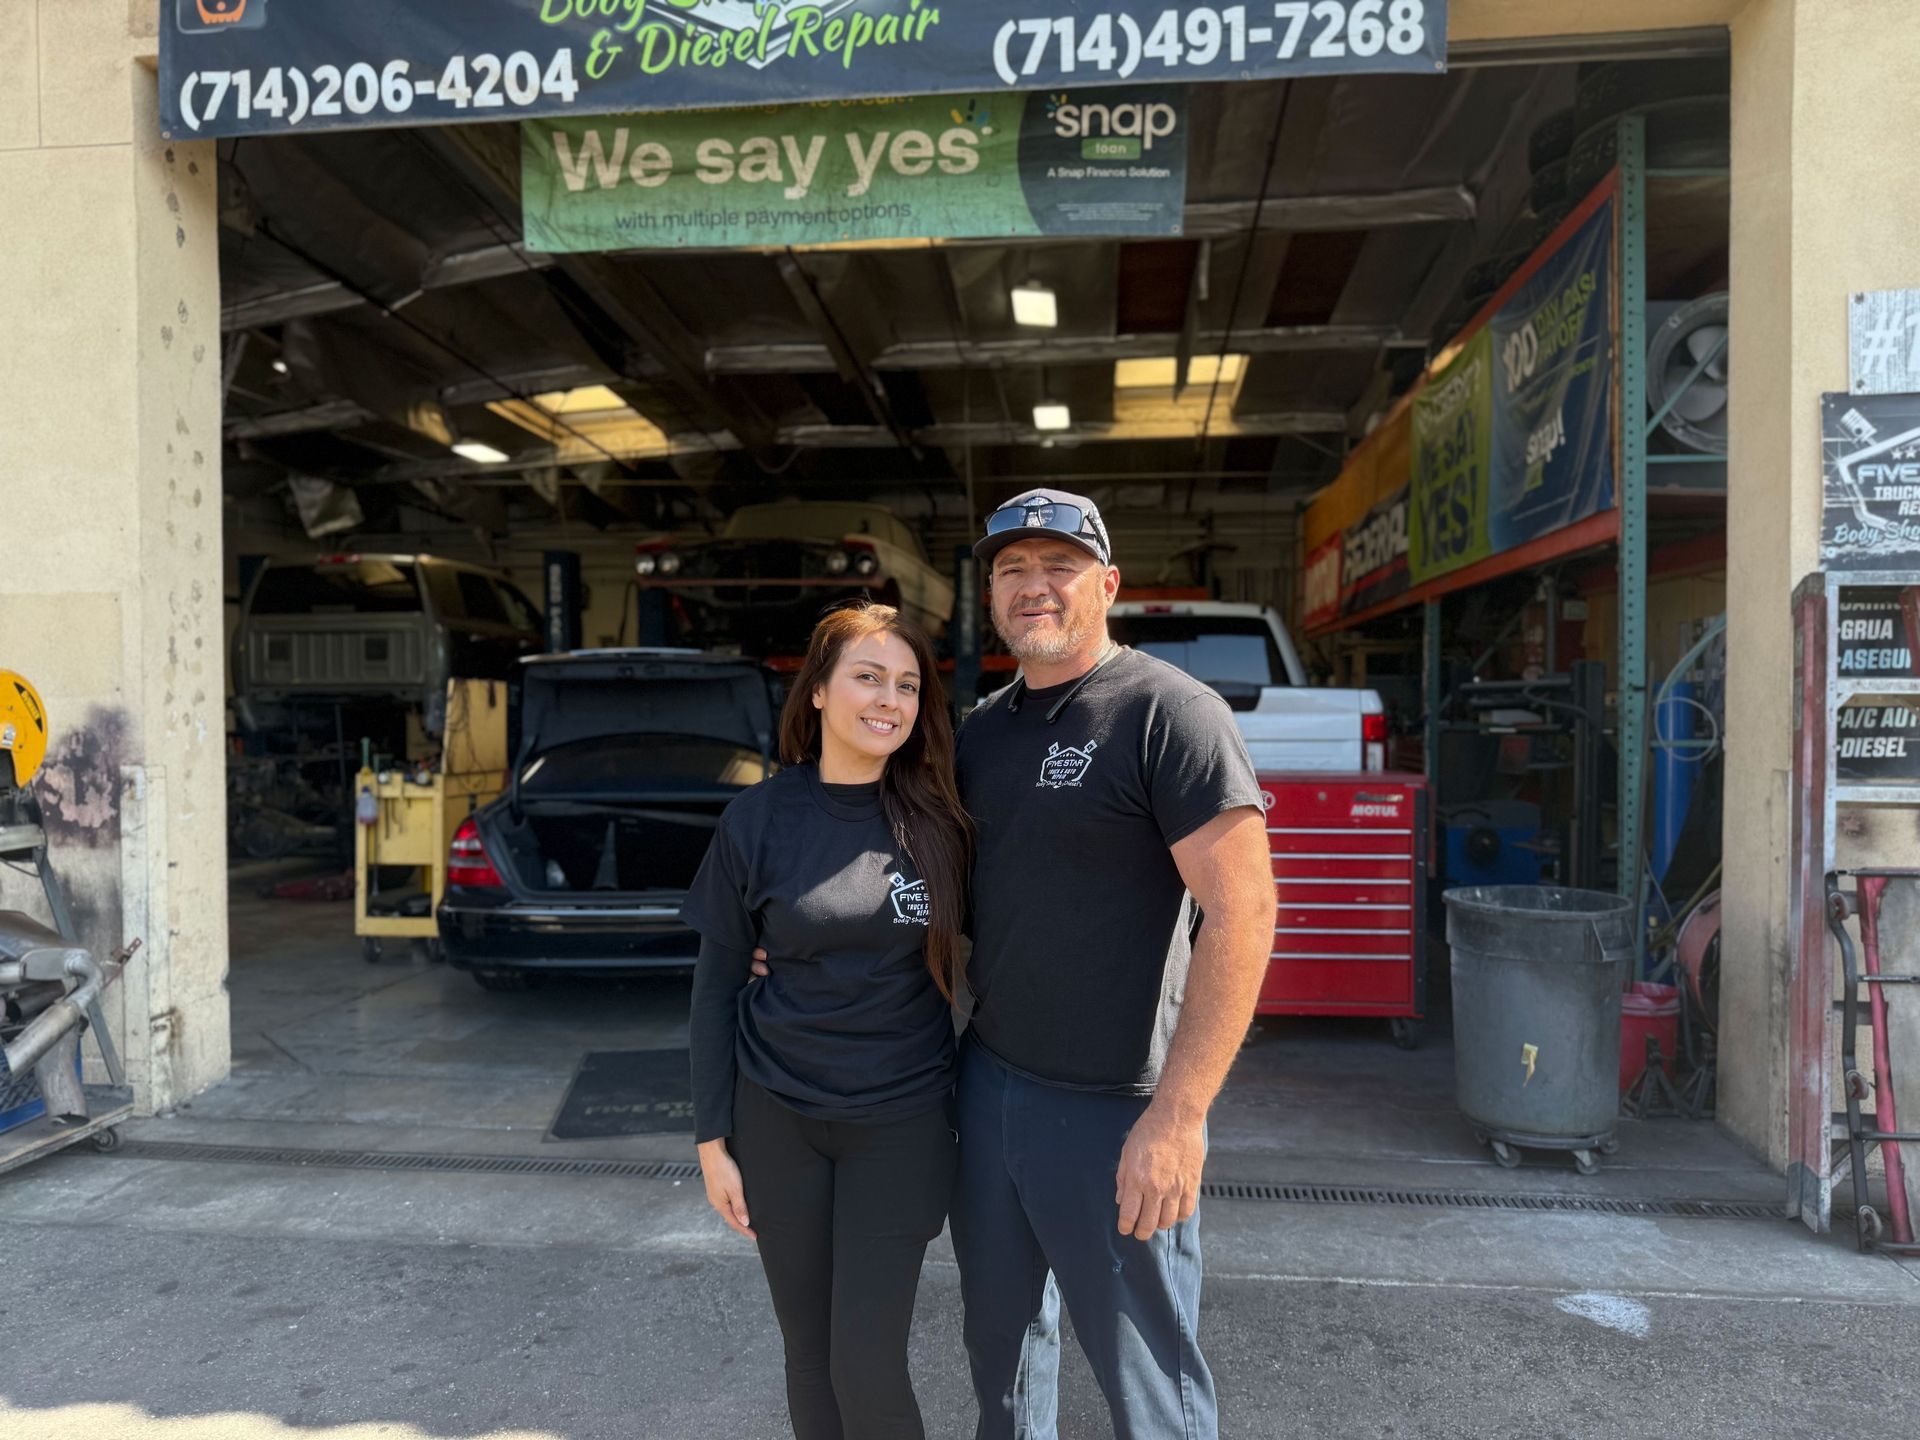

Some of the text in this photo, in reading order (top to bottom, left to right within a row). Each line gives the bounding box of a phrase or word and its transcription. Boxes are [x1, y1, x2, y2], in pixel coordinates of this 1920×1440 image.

[585, 0, 939, 79] & Diesel Repair
[993, 0, 1425, 85] (714)491-7268
[179, 48, 579, 132] (714)206-4204
[1054, 103, 1177, 149] snap
[1096, 142, 1127, 154] loan
[552, 128, 980, 200] We say yes
[1047, 166, 1170, 179] A Snap Finance Solution
[615, 202, 911, 230] with multiple payment options
[1857, 463, 1920, 485] FIVE
[1898, 501, 1920, 516] RE
[1832, 522, 1879, 547] Body
[1840, 618, 1893, 640] GRUA
[1840, 707, 1878, 729] A/C
[1840, 736, 1907, 758] DIESEL
[1047, 759, 1084, 768] FIVE STAR
[1350, 804, 1400, 817] MOTUL
[900, 893, 922, 902] FIVE
[893, 916, 926, 925] Body Shop
